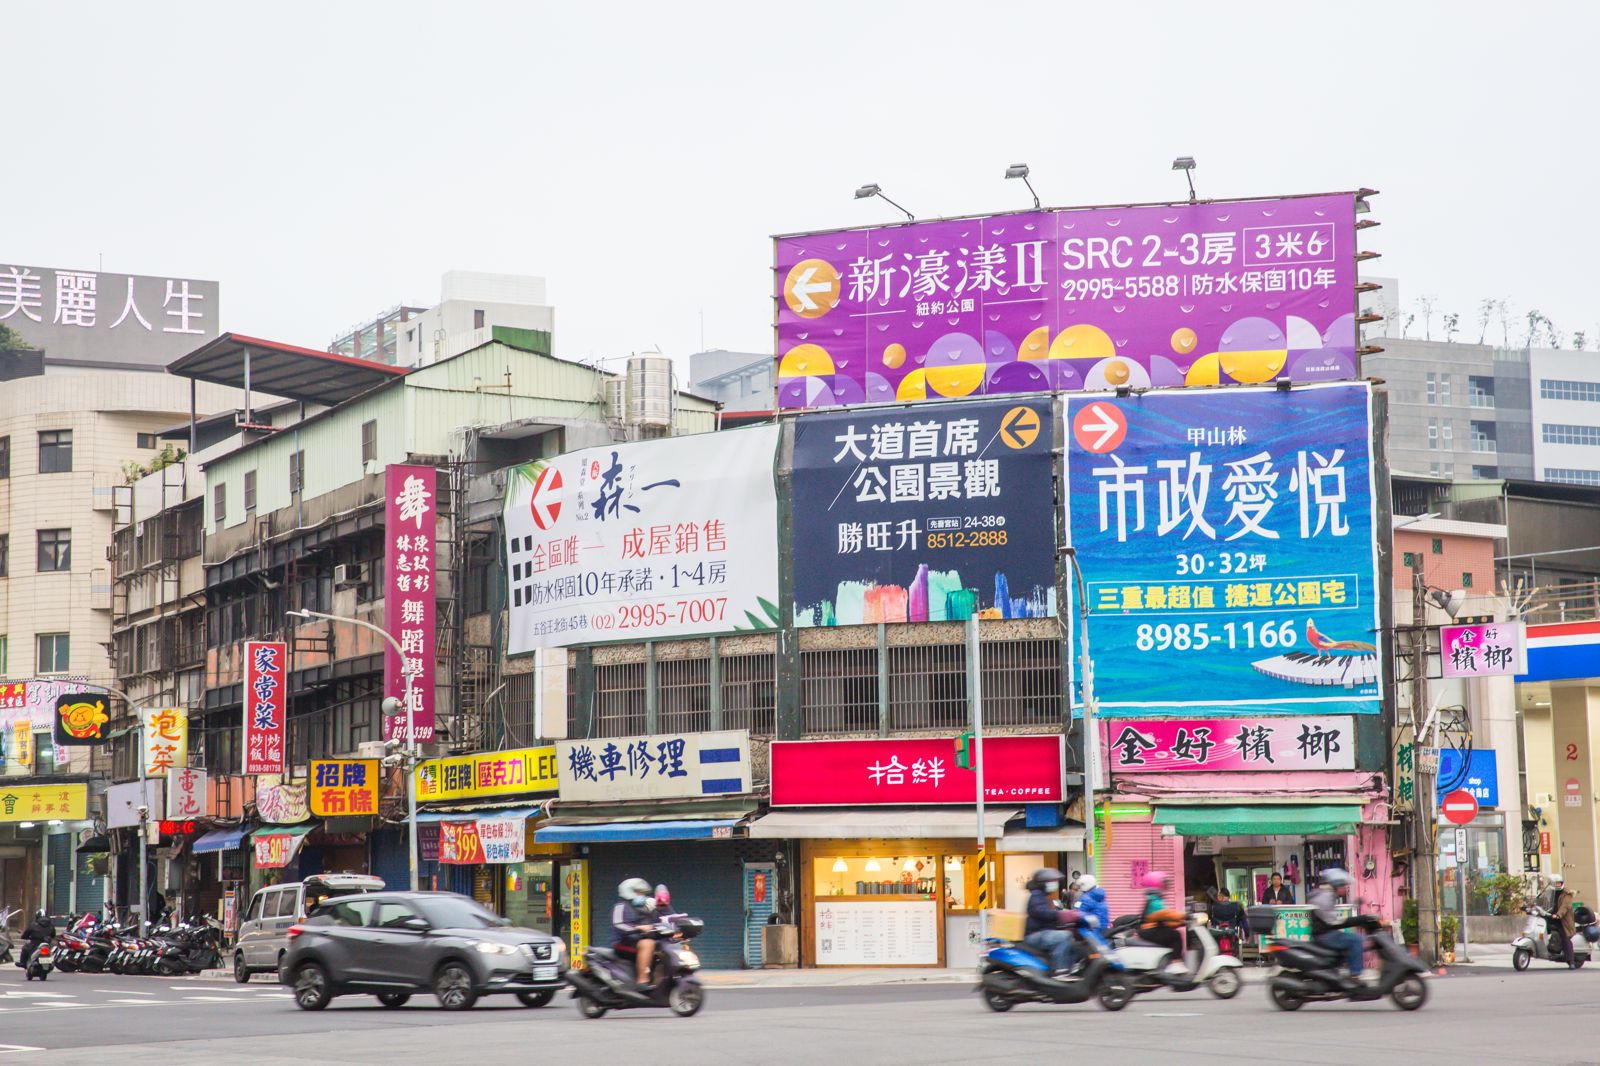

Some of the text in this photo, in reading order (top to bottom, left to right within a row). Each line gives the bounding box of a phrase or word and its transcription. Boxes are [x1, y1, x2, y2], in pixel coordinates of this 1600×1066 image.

[1062, 231, 1237, 270] SRC 2-3房
[1255, 231, 1323, 259] 3米6
[1063, 267, 1337, 300] 2995-5588 防水保固10年
[0, 267, 205, 334] 美麗人生
[916, 299, 974, 316] 紐約公園
[833, 418, 980, 464] 大道首席
[1187, 426, 1248, 447] 甲山林
[853, 460, 1001, 503] 公園景觀
[395, 474, 432, 530] 舞
[532, 519, 726, 573] 全區唯一 成屋銷售
[837, 519, 922, 554] 勝旺升
[927, 530, 1008, 549] 8512-2888
[1097, 580, 1346, 610] 三重最超值 捷運公園宅
[591, 615, 615, 630] (02)
[618, 598, 728, 629] 2995-7007
[1136, 620, 1297, 651] 8985-1166
[1461, 628, 1498, 643] 金好
[1451, 645, 1513, 672] 檳榔
[254, 646, 279, 730] 家常菜
[394, 716, 407, 725] 3F
[149, 709, 181, 774] 泡菜
[250, 734, 264, 761] 炒飯
[1111, 724, 1341, 766] 金好檳榔
[1566, 744, 1578, 761] 2
[316, 763, 366, 787] 招牌
[478, 758, 523, 788] 壓克力
[529, 755, 557, 781] LED
[568, 738, 688, 782] 機車修理
[178, 770, 200, 815] 電池
[444, 764, 472, 791] 招牌
[322, 788, 373, 813] 布條
